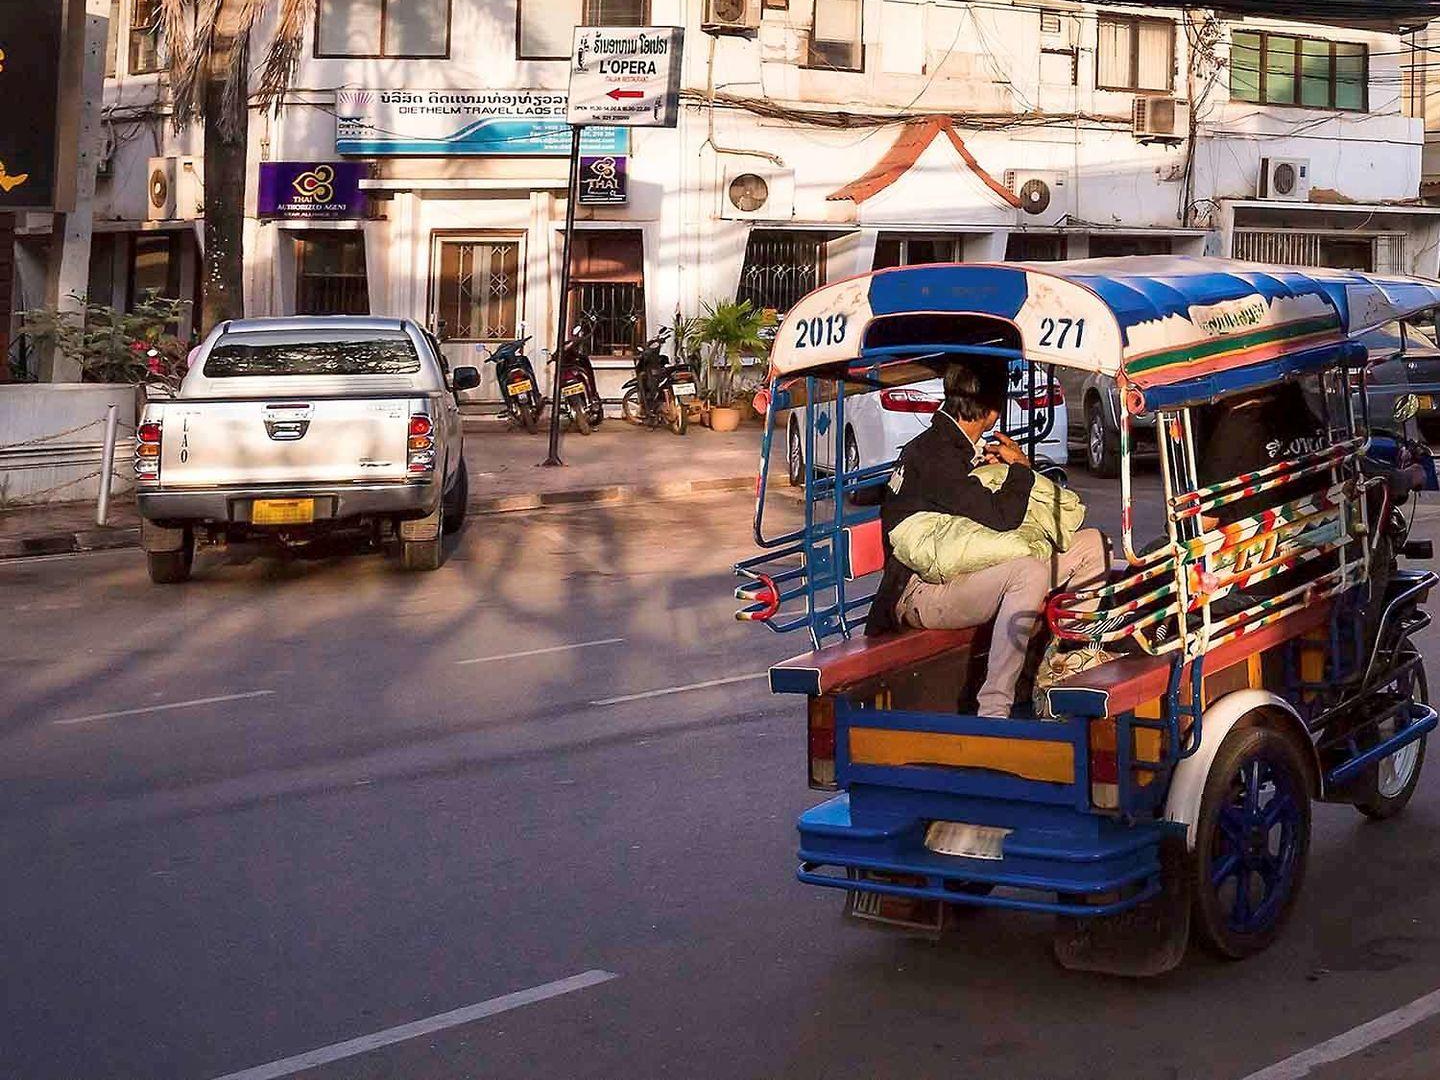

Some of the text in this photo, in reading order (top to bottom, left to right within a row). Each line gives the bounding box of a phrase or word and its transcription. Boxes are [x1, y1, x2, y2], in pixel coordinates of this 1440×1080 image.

[599, 60, 656, 74] L'OPERA
[795, 314, 847, 349] 2013
[1039, 317, 1086, 349] 271
